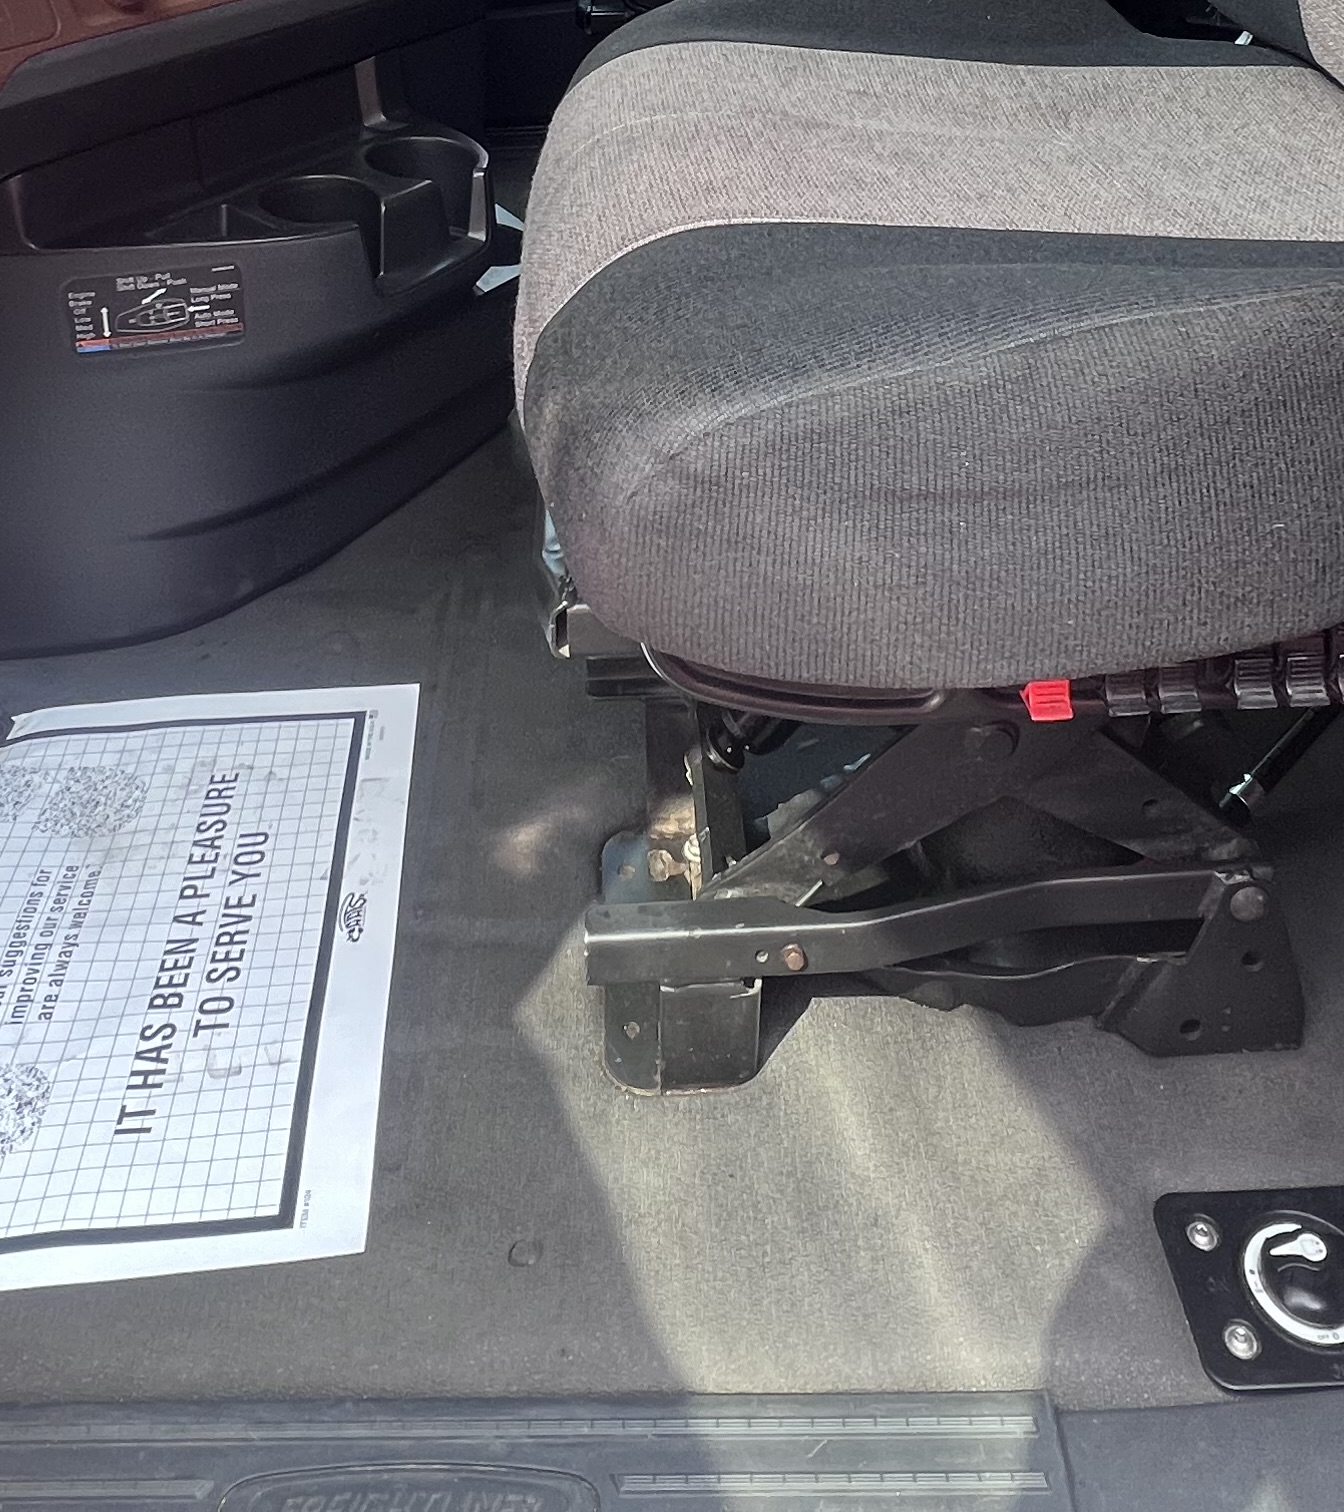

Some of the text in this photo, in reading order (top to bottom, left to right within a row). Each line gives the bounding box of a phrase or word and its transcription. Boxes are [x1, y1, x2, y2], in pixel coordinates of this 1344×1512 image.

[0, 891, 44, 977] suggestions
[31, 869, 52, 886] for
[5, 866, 79, 1025] improving our service
[48, 933, 79, 988] always
[113, 771, 240, 1135] IT HAS BEEN A PLEASURE
[192, 830, 271, 1039] TO SERVE YOU
[38, 994, 59, 1021] are
